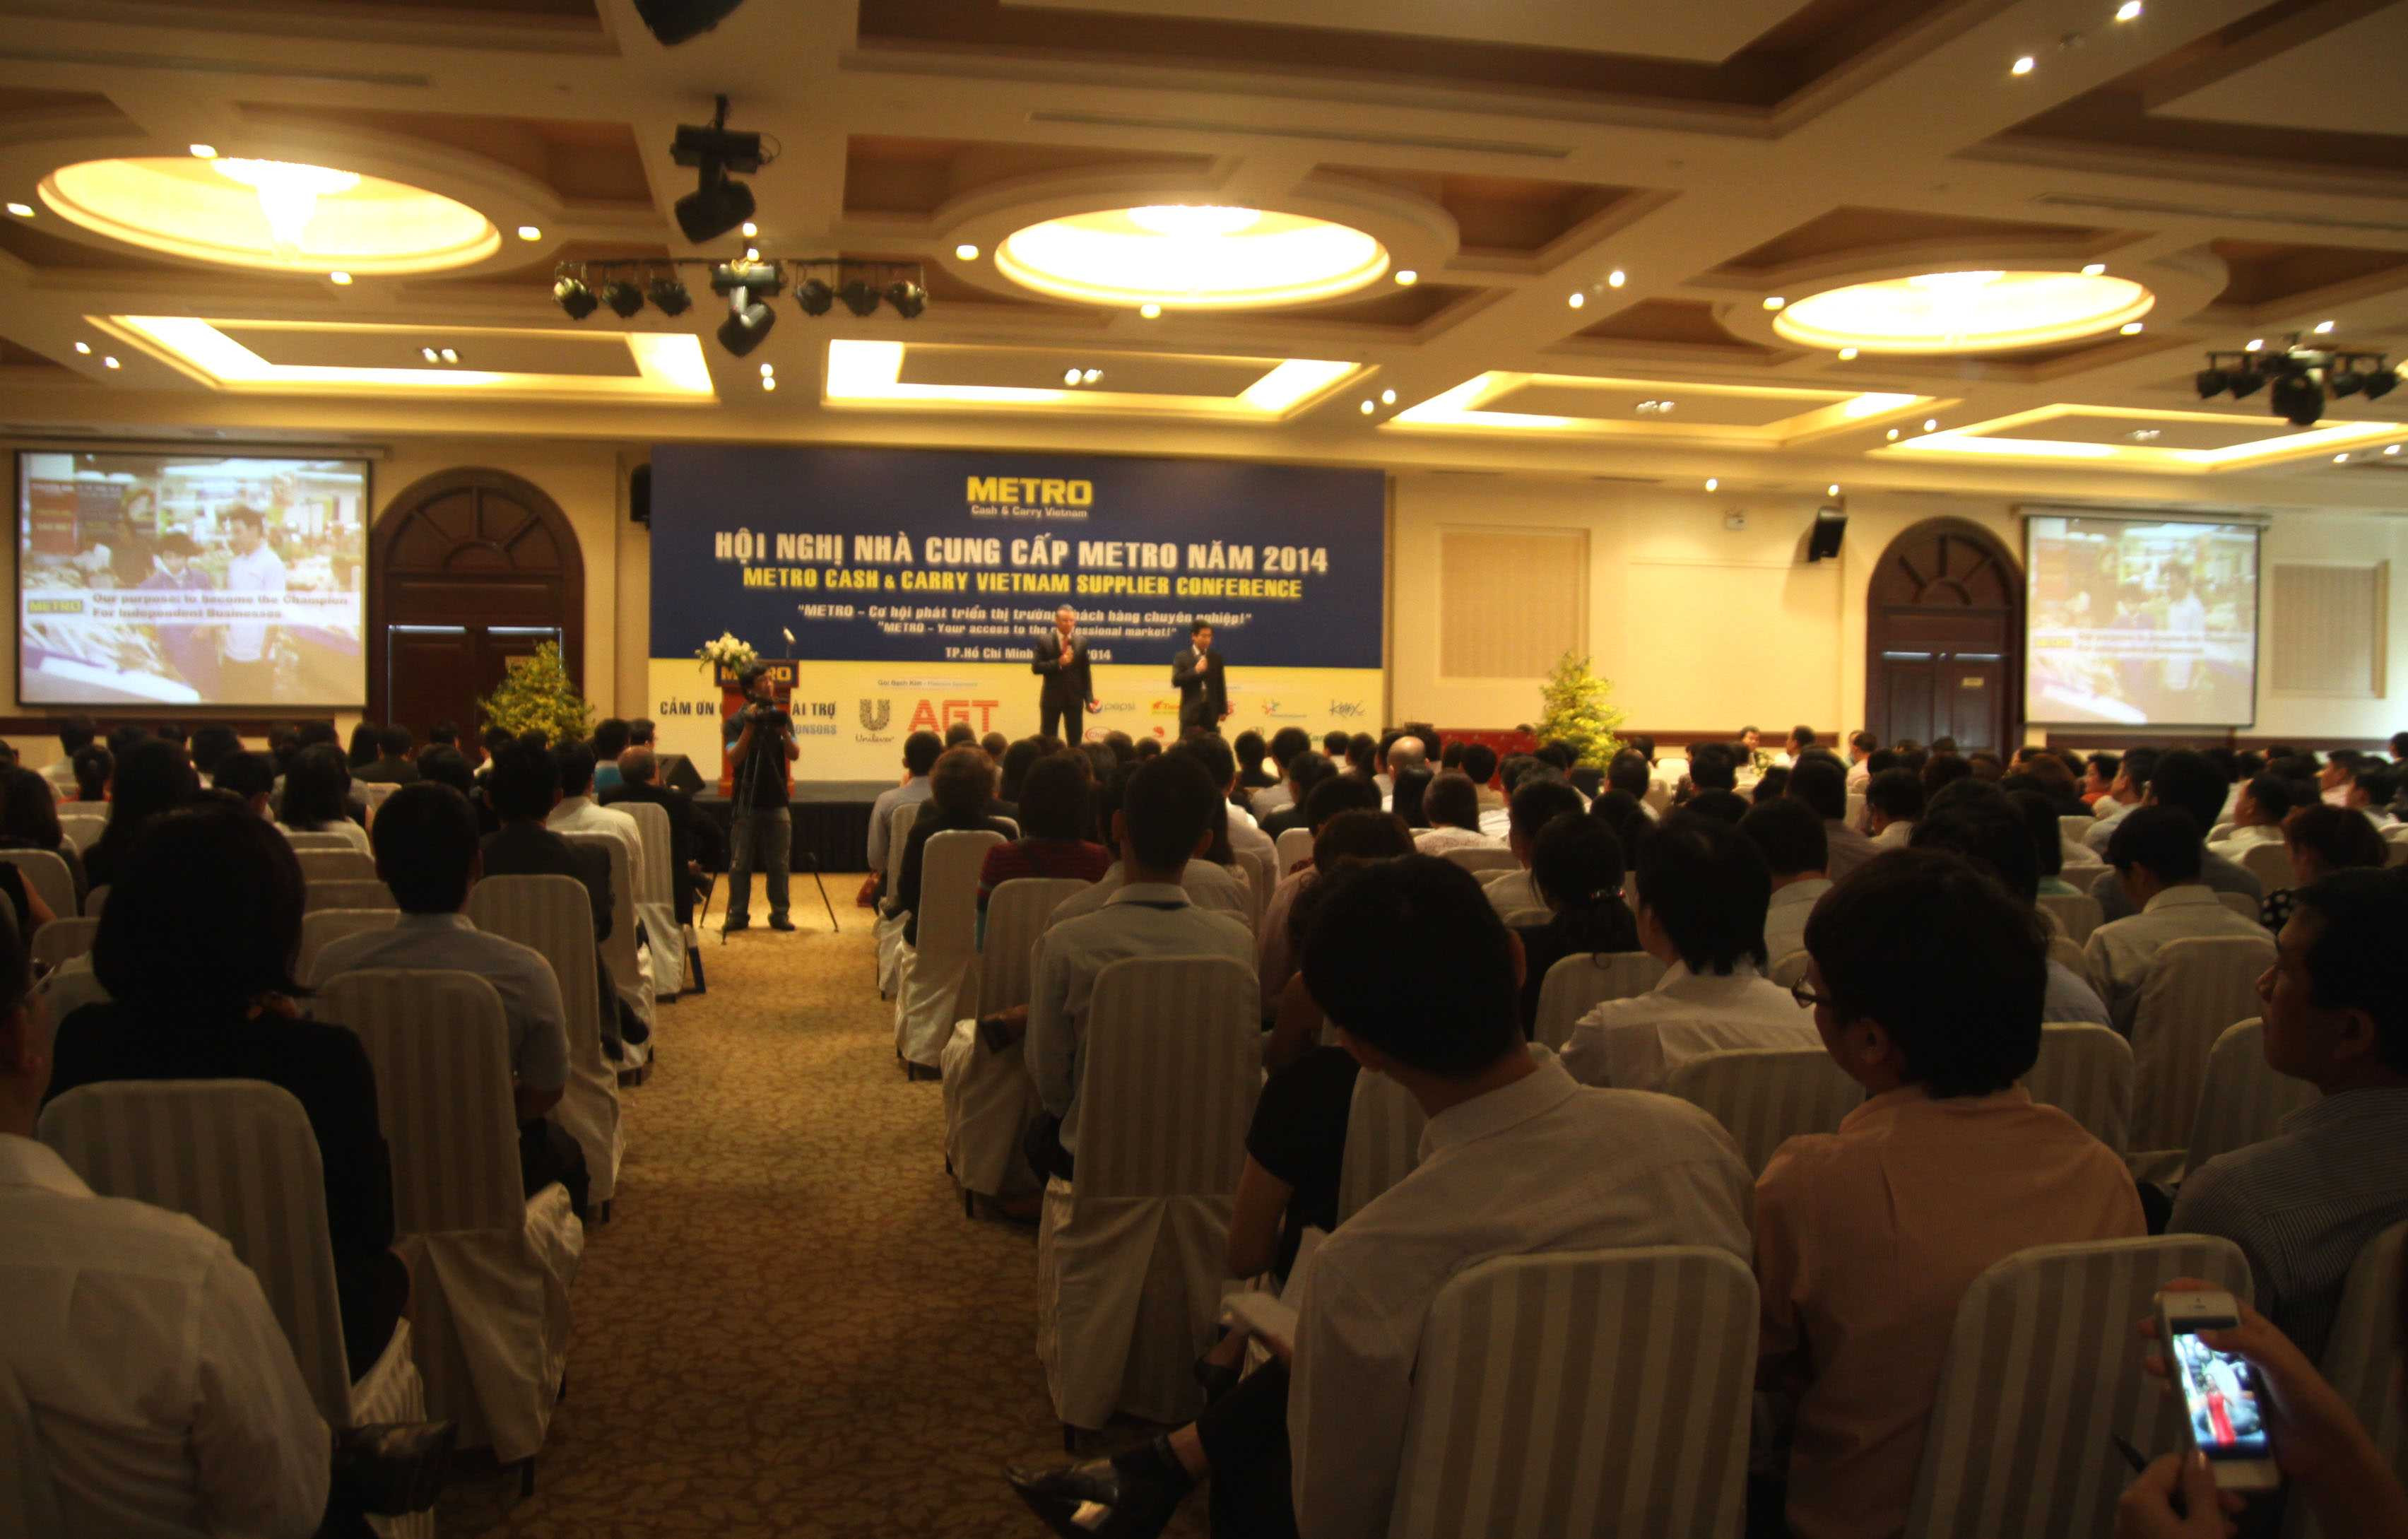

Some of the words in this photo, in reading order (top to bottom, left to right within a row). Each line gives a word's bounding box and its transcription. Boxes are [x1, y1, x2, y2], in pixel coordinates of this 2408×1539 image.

[967, 476, 1092, 505] METRO
[972, 505, 998, 515] Cash
[1001, 506, 1009, 516] &
[1013, 507, 1041, 518] Carry
[1044, 507, 1087, 517] Vietnam
[714, 527, 765, 565] HỘI
[776, 533, 843, 566] NGHỊ
[854, 531, 913, 563] NHÀ
[924, 536, 1001, 565] CUNG
[1010, 532, 1068, 566] CẤP
[1079, 541, 1178, 569] METRO
[1188, 539, 1253, 570] NĂM
[1263, 546, 1328, 573] 2014
[743, 567, 818, 588] METRO
[825, 569, 880, 589] CASH
[884, 574, 896, 589] &
[901, 570, 969, 590] CARRY
[976, 572, 1070, 593] VIETNAM
[1076, 574, 1170, 595] SUPPLIER
[1176, 577, 1302, 598] CONFERENCE
[93, 594, 116, 603] Our
[184, 594, 197, 603] to
[258, 595, 278, 604] the
[283, 596, 348, 607] Champion
[938, 623, 966, 634] Your
[969, 625, 1010, 635] access
[1013, 625, 1025, 635] to
[1029, 625, 1047, 635] the
[1005, 647, 1034, 659] Minh
[792, 700, 806, 715] ÀI
[908, 699, 998, 732] AGT
